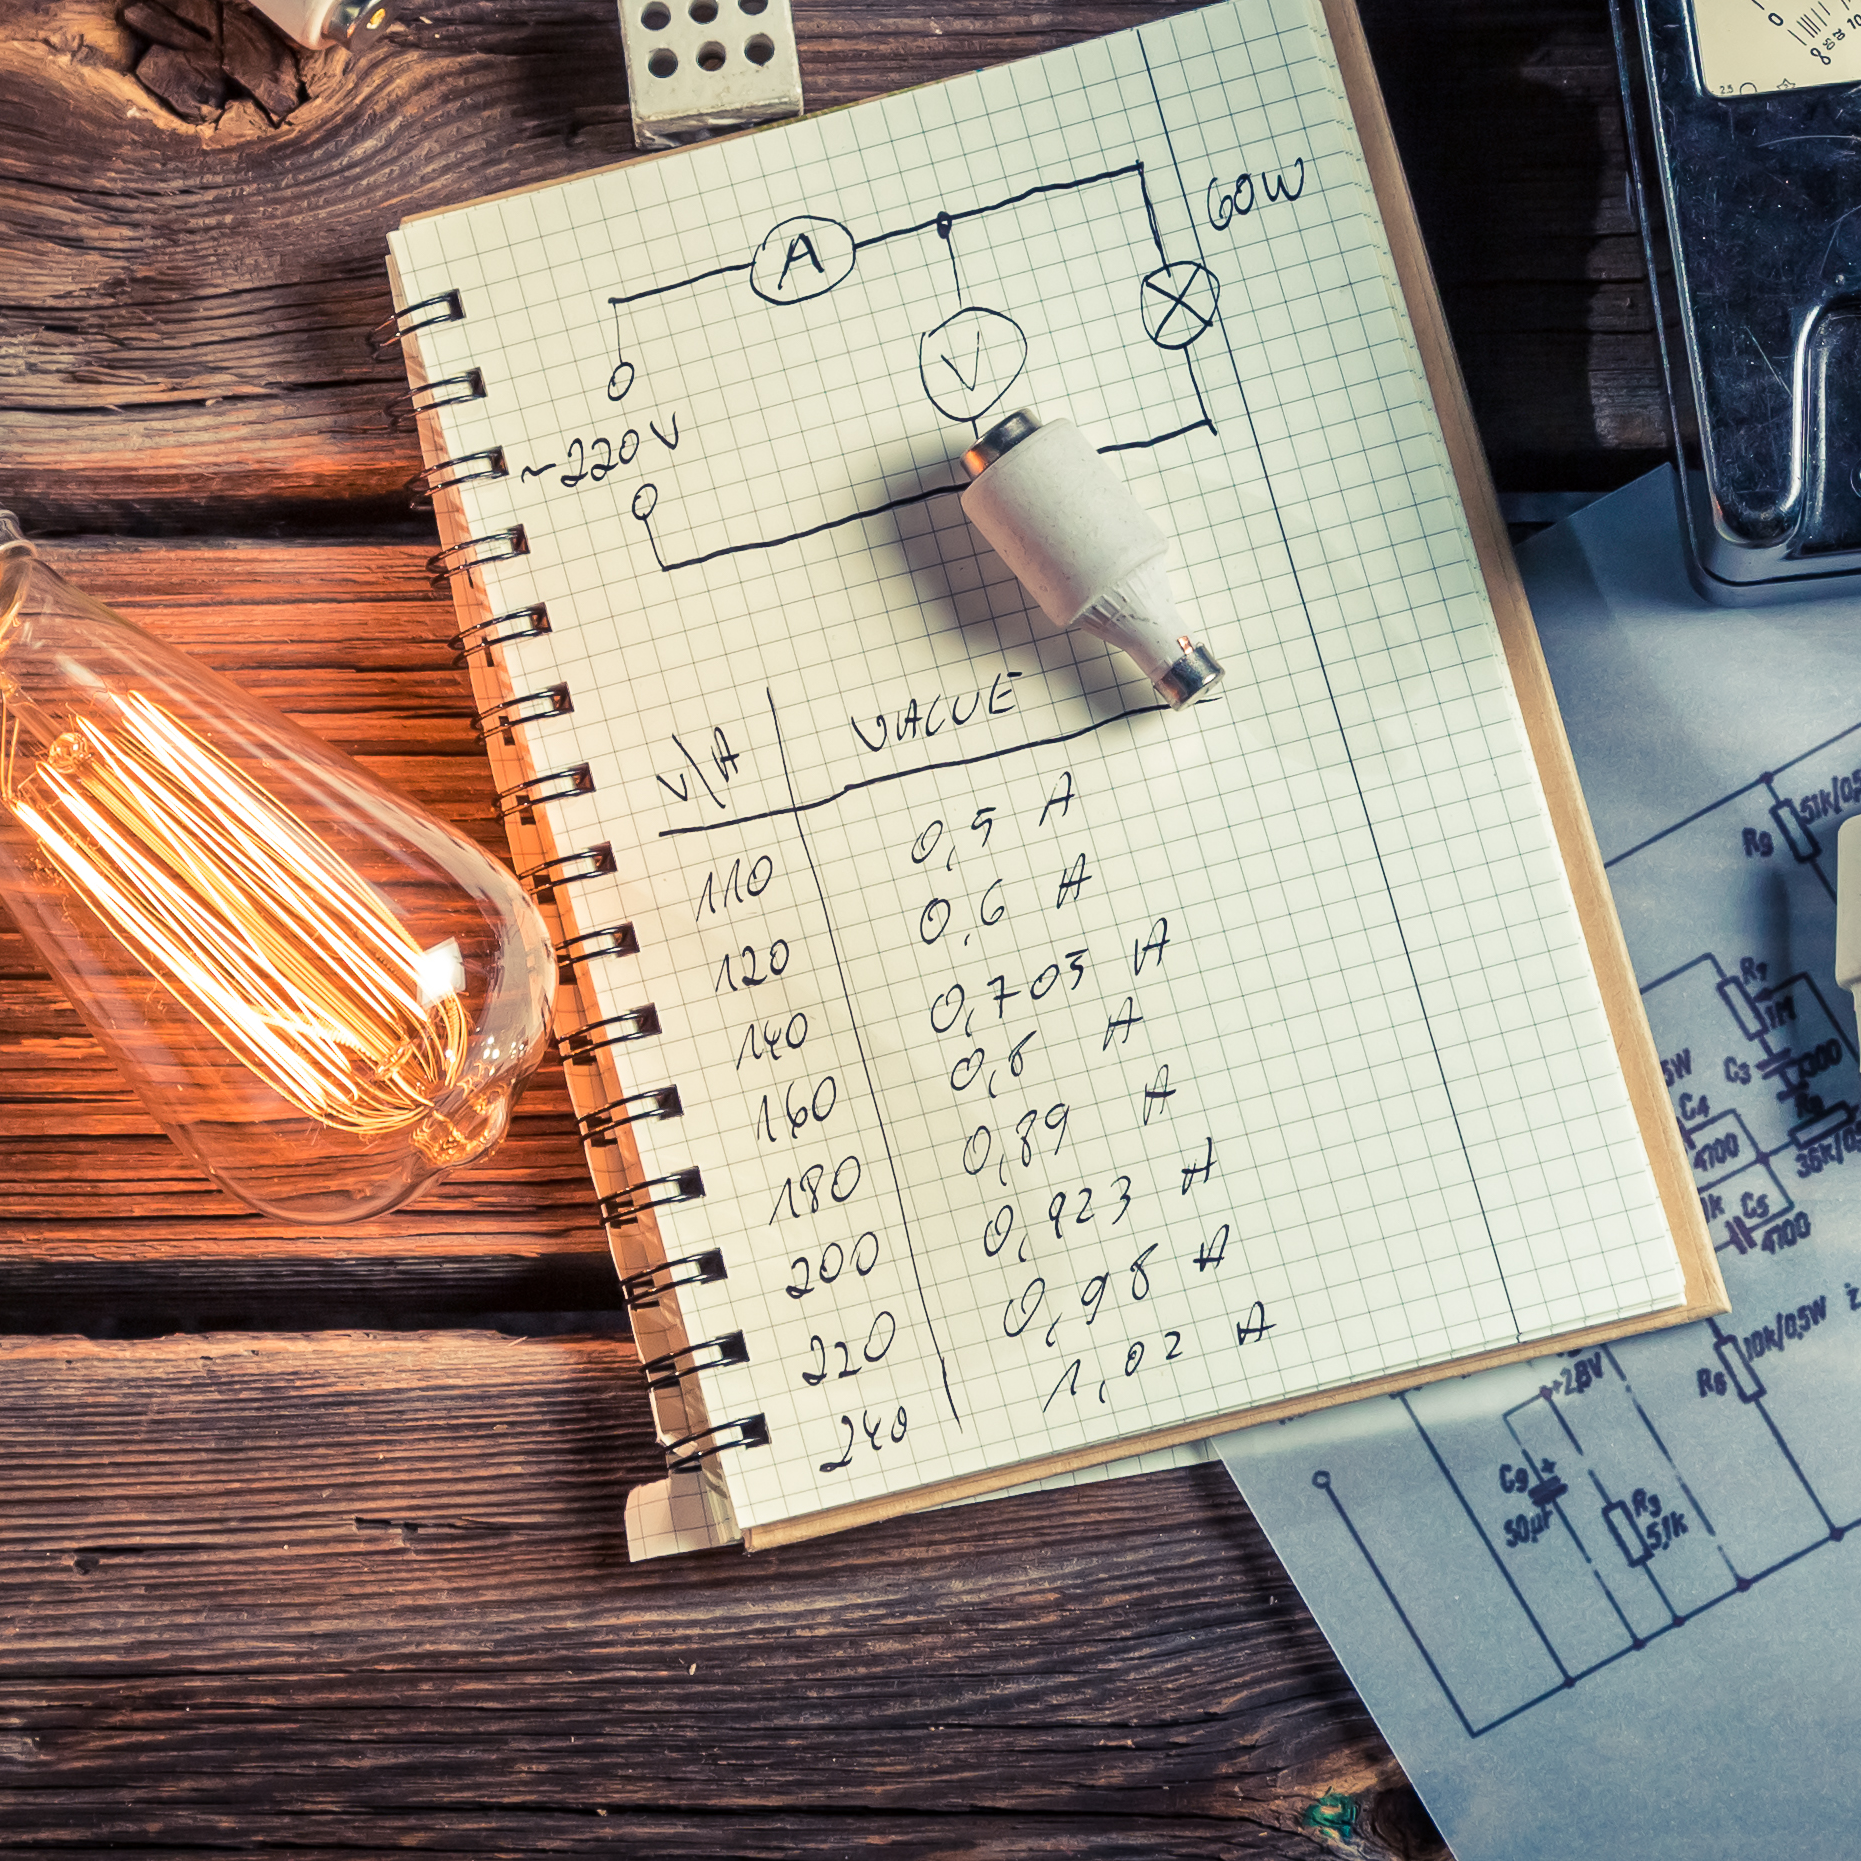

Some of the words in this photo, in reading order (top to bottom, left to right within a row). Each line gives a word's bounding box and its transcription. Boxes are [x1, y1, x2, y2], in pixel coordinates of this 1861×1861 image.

[1767, 10, 1785, 29] 0
[1820, 36, 1837, 52] 50
[777, 235, 825, 291] A
[1205, 156, 1307, 232] 60W
[940, 330, 983, 393] V
[694, 853, 775, 924] 110
[1037, 770, 1077, 828] A
[714, 937, 791, 994] 120
[918, 877, 1007, 948] 0,6
[1055, 851, 1094, 911] A
[735, 1011, 809, 1072] 140
[1132, 915, 1172, 977] A
[756, 1074, 838, 1144] 160
[1102, 994, 1144, 1052] A
[768, 1154, 862, 1227] 180
[961, 1101, 1072, 1187] 0,89
[1142, 1062, 1177, 1126] A
[784, 1229, 881, 1299] 200
[982, 1173, 1133, 1264] 0,923
[1179, 1134, 1217, 1198] A
[800, 1308, 897, 1387] 220
[1192, 1222, 1232, 1273] A
[818, 1403, 909, 1473] 240
[1041, 1328, 1185, 1414] 1,02
[1235, 1299, 1278, 1348] A
